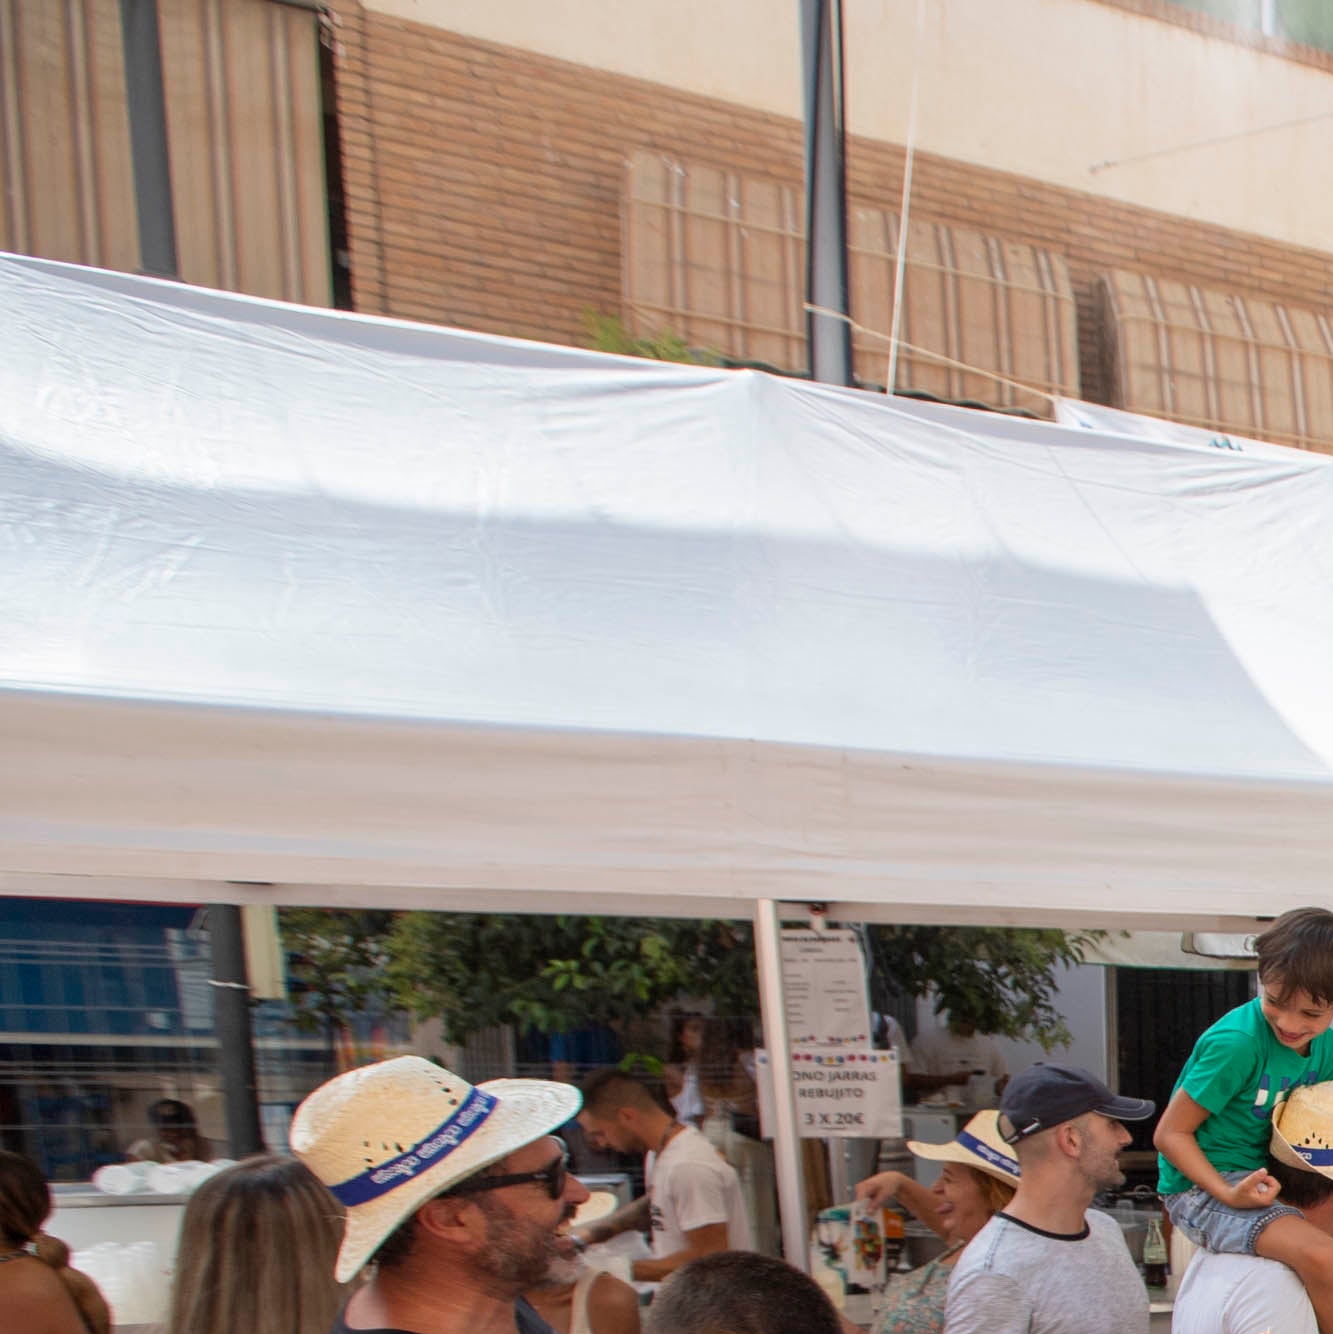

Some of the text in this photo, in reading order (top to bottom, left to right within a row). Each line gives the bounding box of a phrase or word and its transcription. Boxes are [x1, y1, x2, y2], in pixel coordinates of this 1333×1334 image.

[828, 1071, 876, 1082] JARRAS
[799, 1087, 865, 1099] REBUJITO
[835, 1112, 865, 1125] 20€
